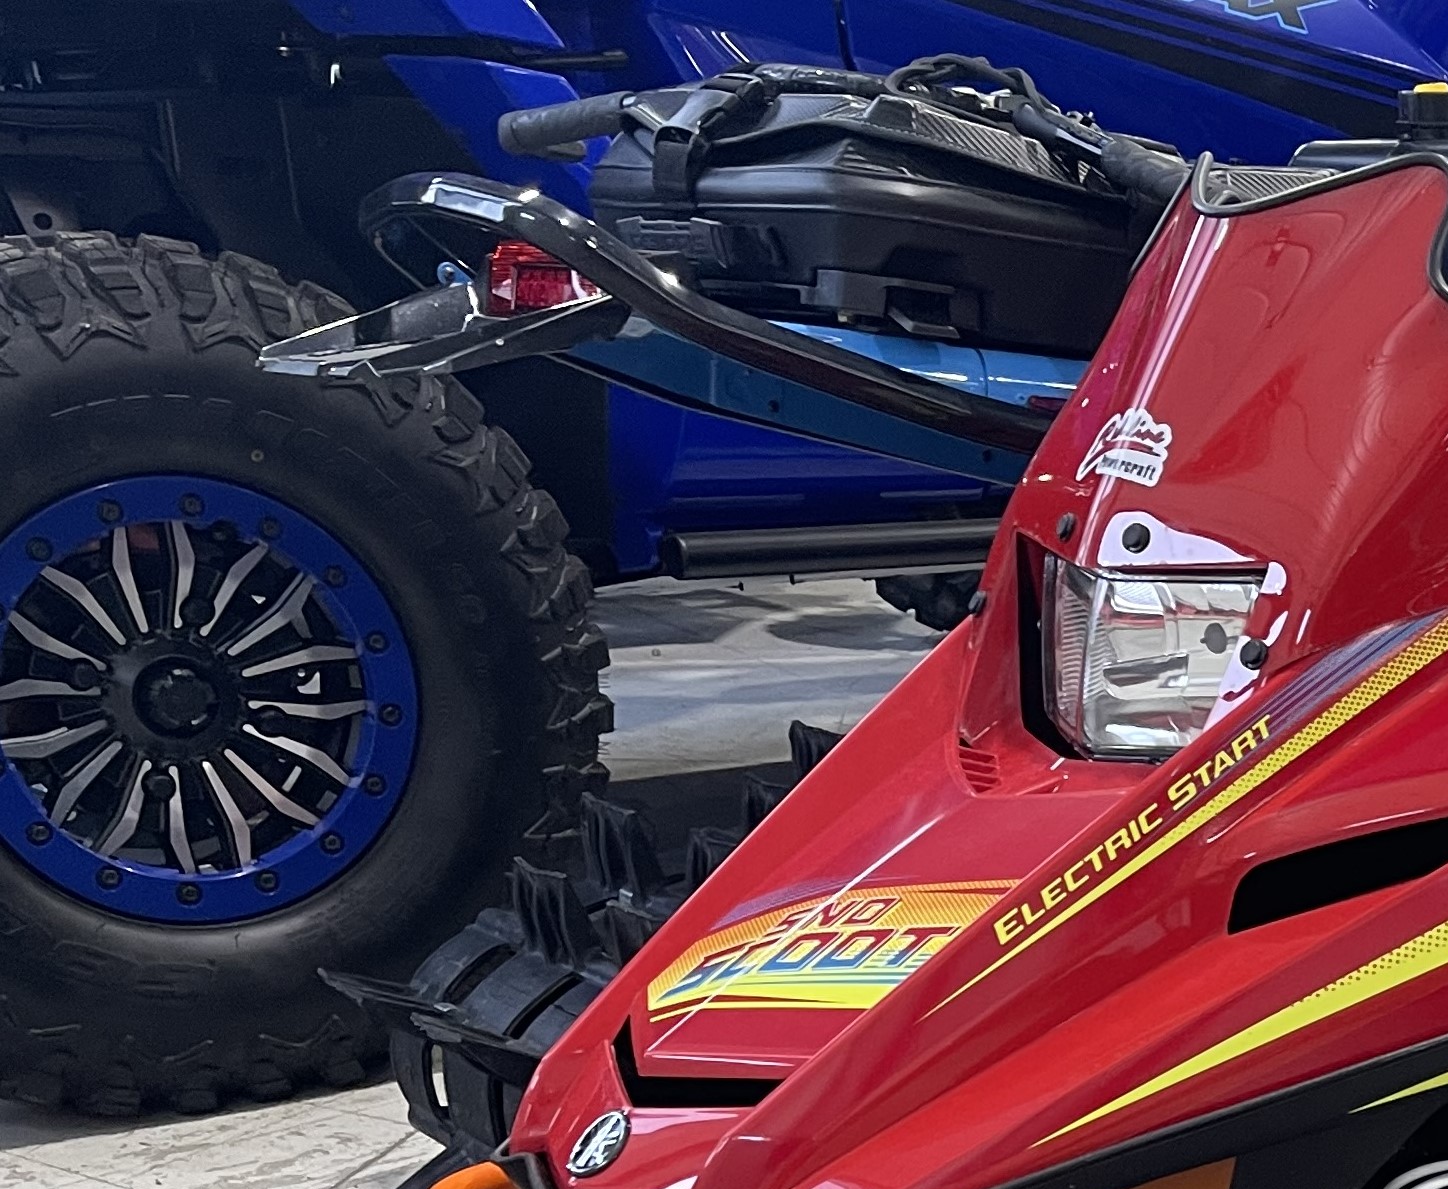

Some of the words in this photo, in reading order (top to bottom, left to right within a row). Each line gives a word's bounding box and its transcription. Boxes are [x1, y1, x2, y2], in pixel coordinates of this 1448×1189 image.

[993, 803, 1163, 945] ELECTRIC
[1167, 714, 1271, 811] START
[767, 897, 901, 936] SNO
[656, 925, 961, 1003] SCOOT
